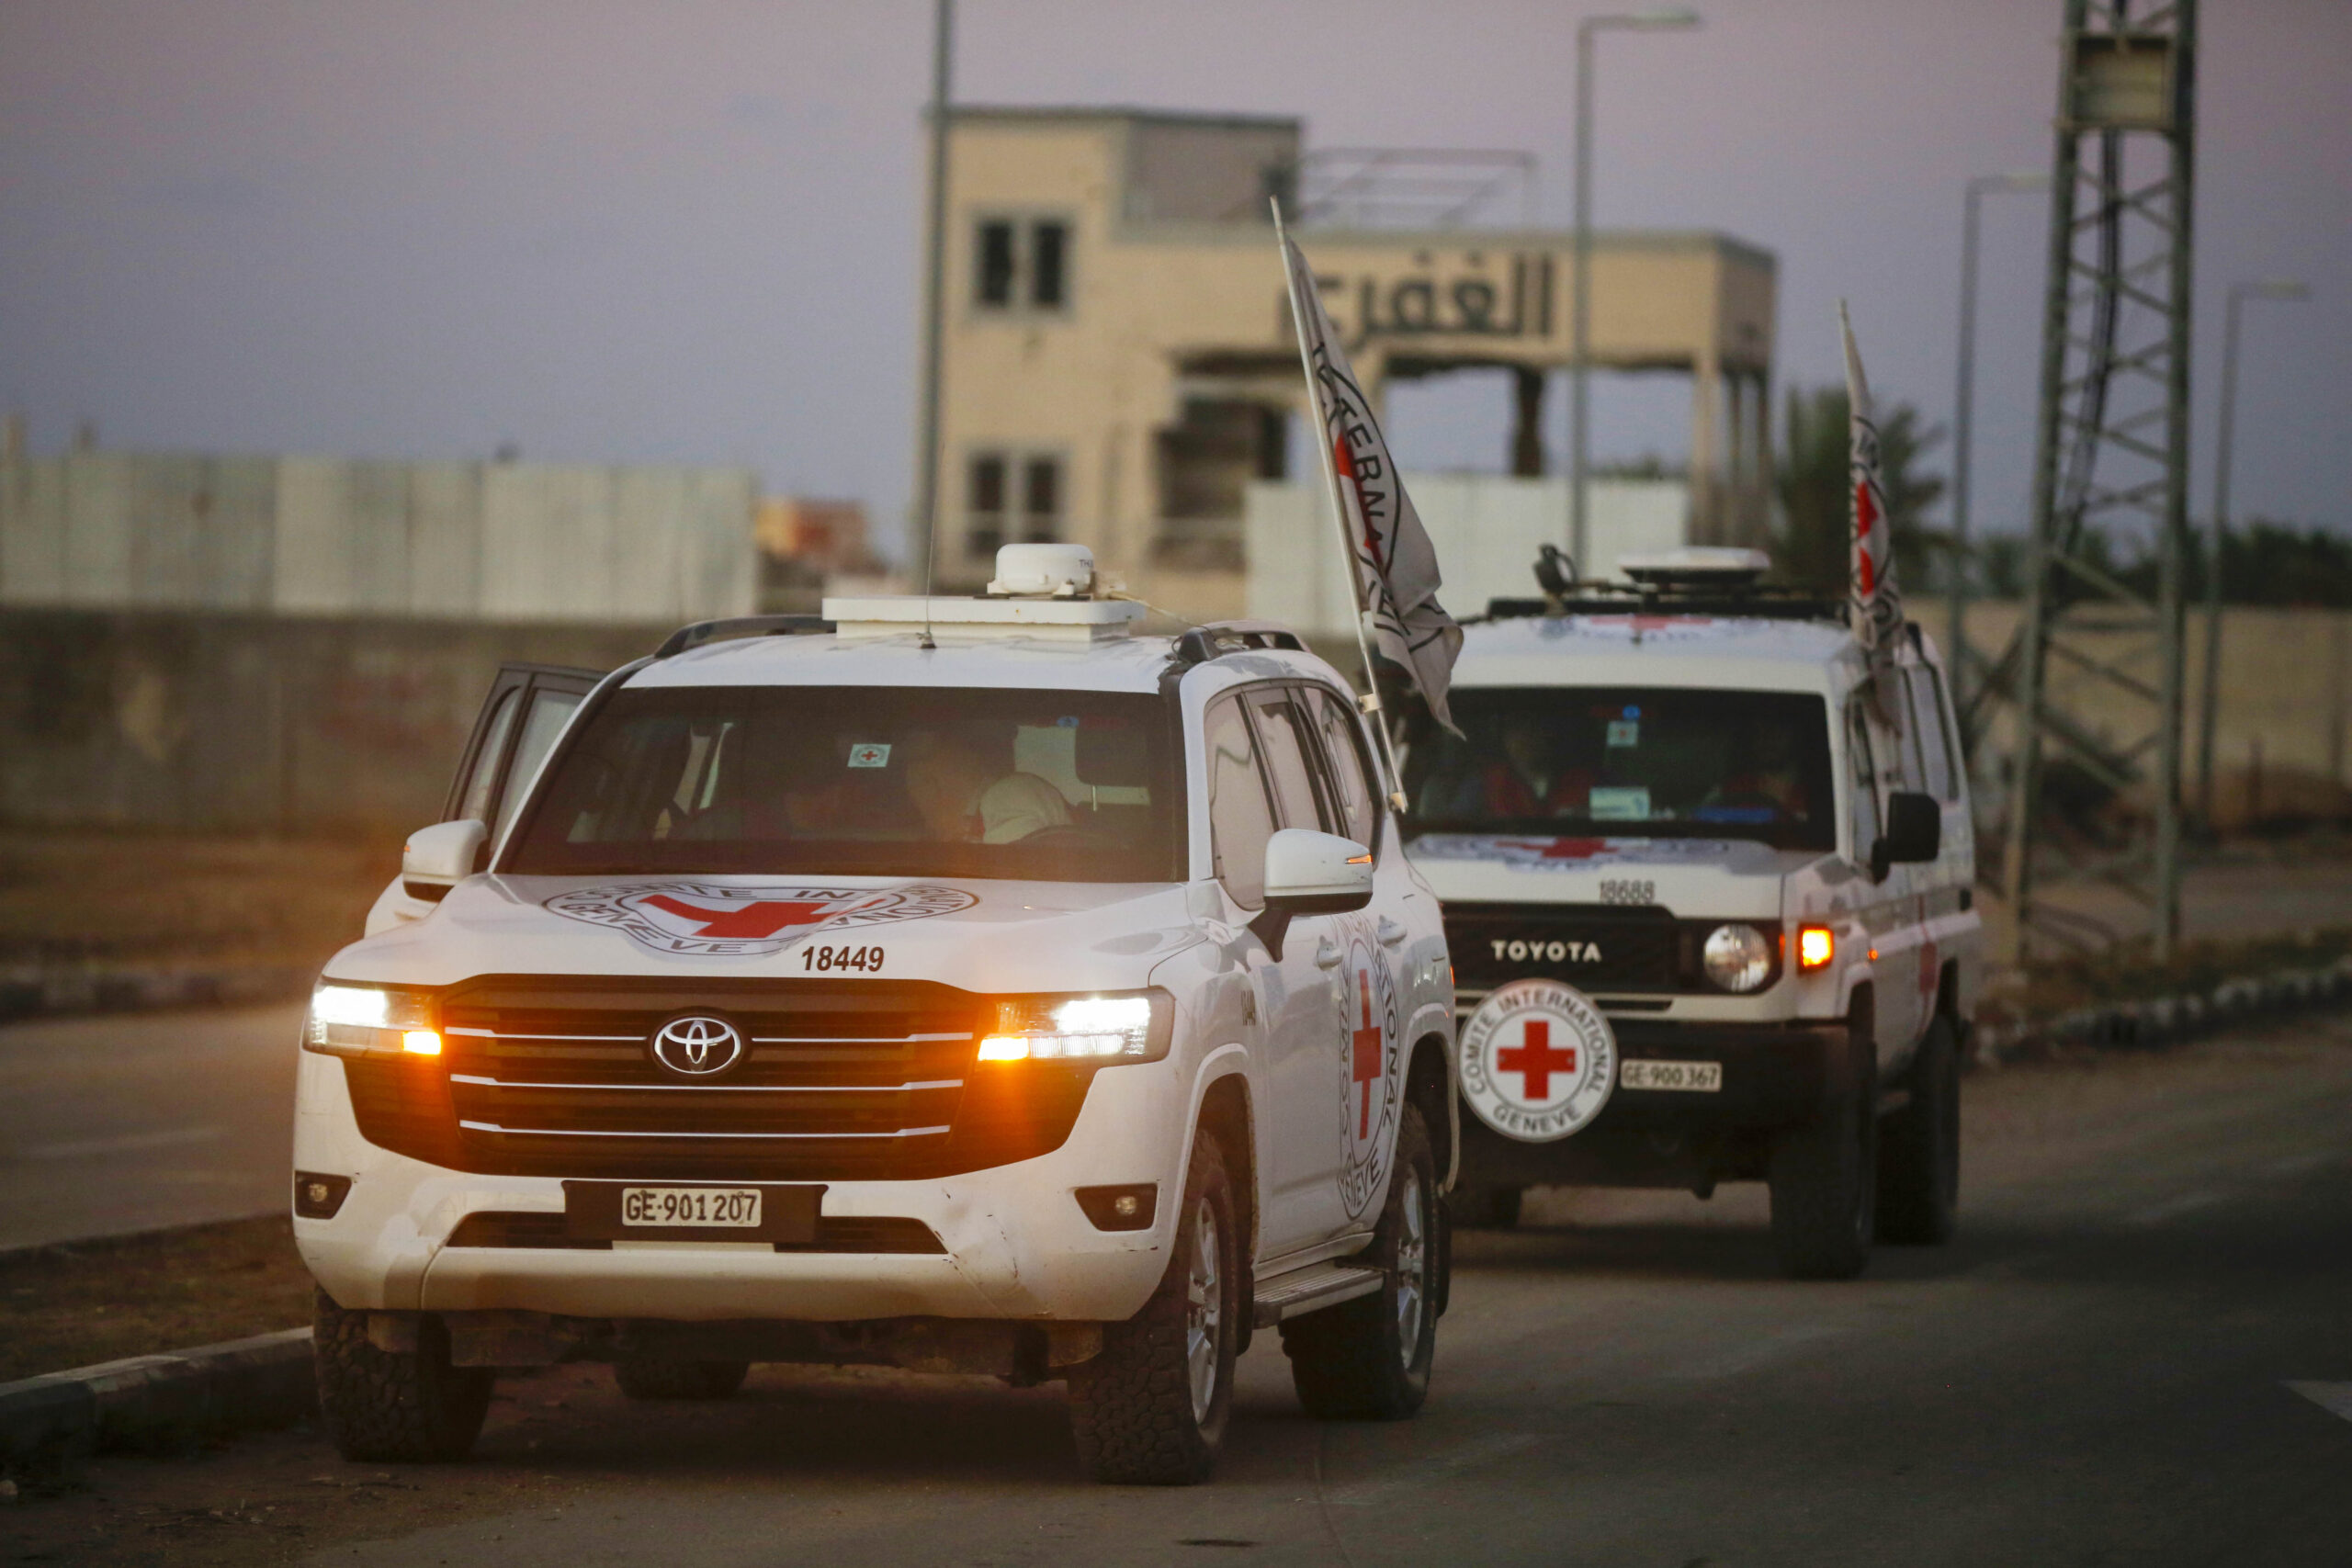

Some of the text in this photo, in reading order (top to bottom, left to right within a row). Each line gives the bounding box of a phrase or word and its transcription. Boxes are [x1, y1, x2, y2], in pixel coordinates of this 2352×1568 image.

[560, 902, 748, 953] GENEVE
[801, 946, 885, 972] 18449
[1491, 940, 1602, 962] TOYOTA
[1464, 987, 1608, 1095] COMITE INTERNATIONAL
[1493, 1105, 1580, 1133] GENEVE
